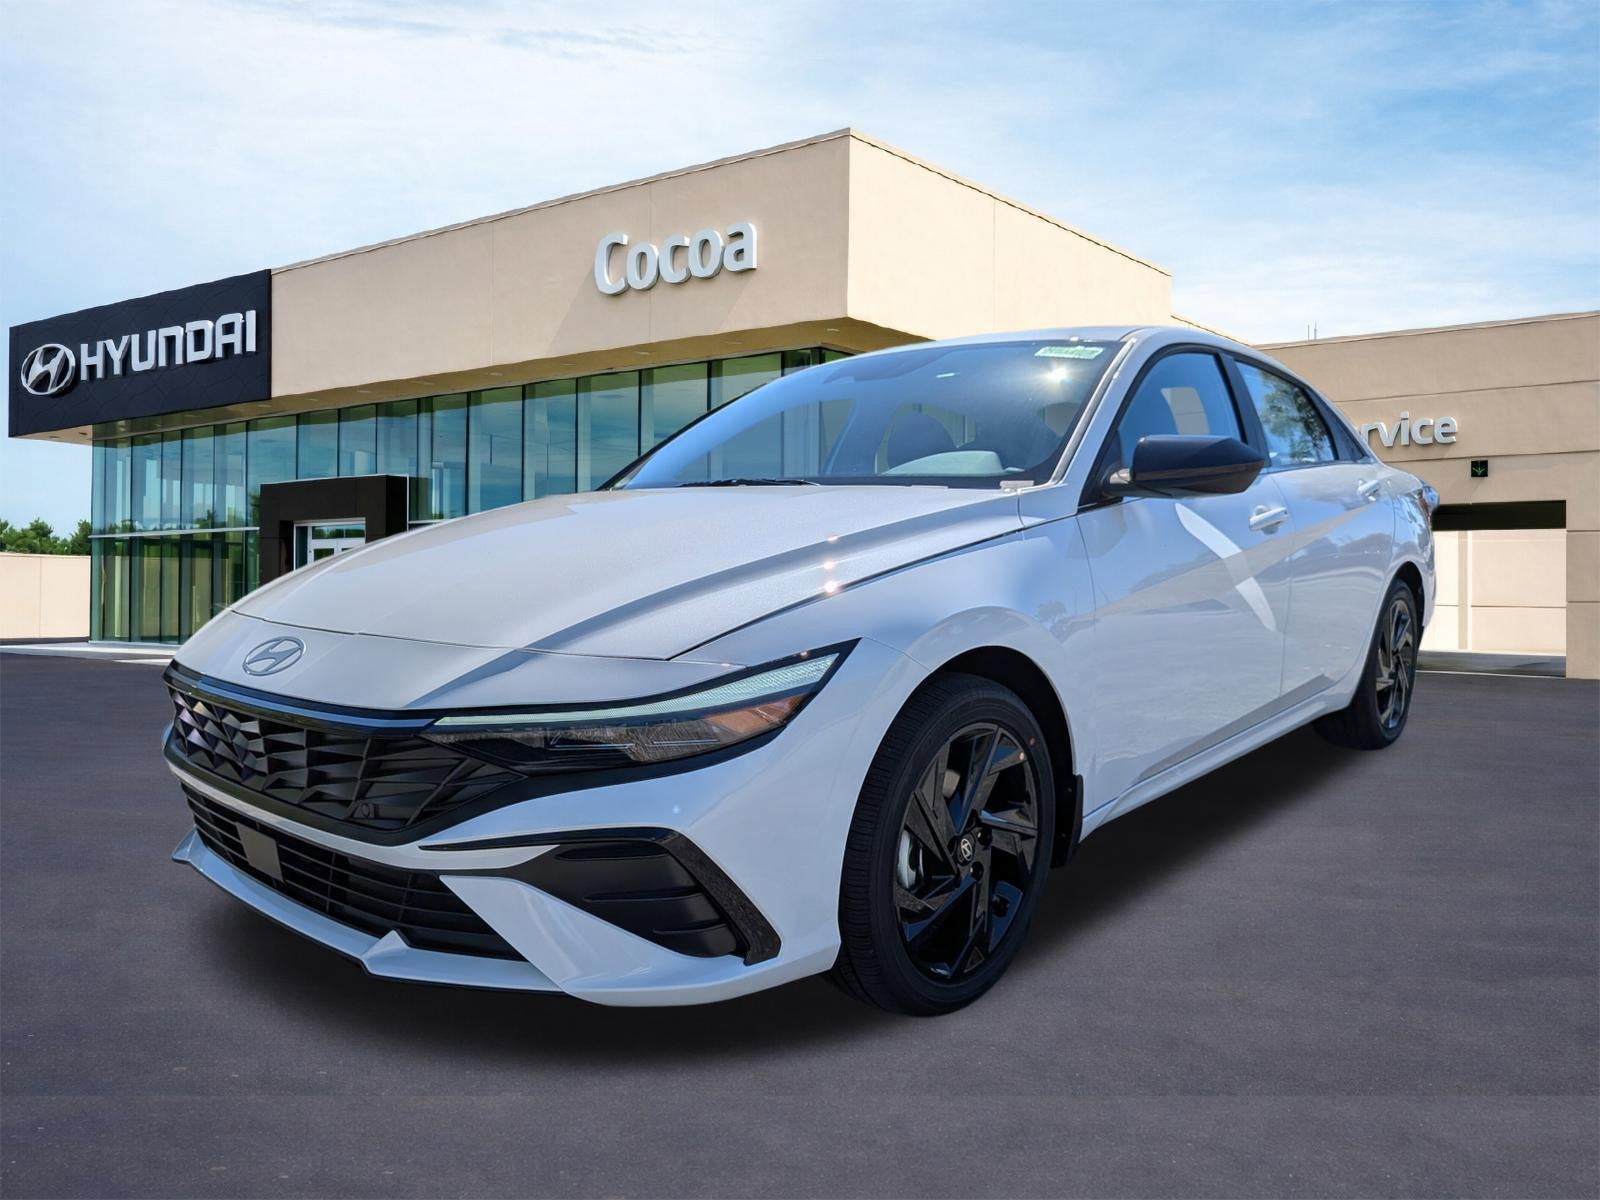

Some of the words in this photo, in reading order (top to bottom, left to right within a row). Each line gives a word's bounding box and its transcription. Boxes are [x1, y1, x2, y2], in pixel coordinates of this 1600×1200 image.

[594, 222, 758, 295] Cocoa
[79, 309, 257, 382] HYUNDAI
[1356, 410, 1458, 448] rvice
